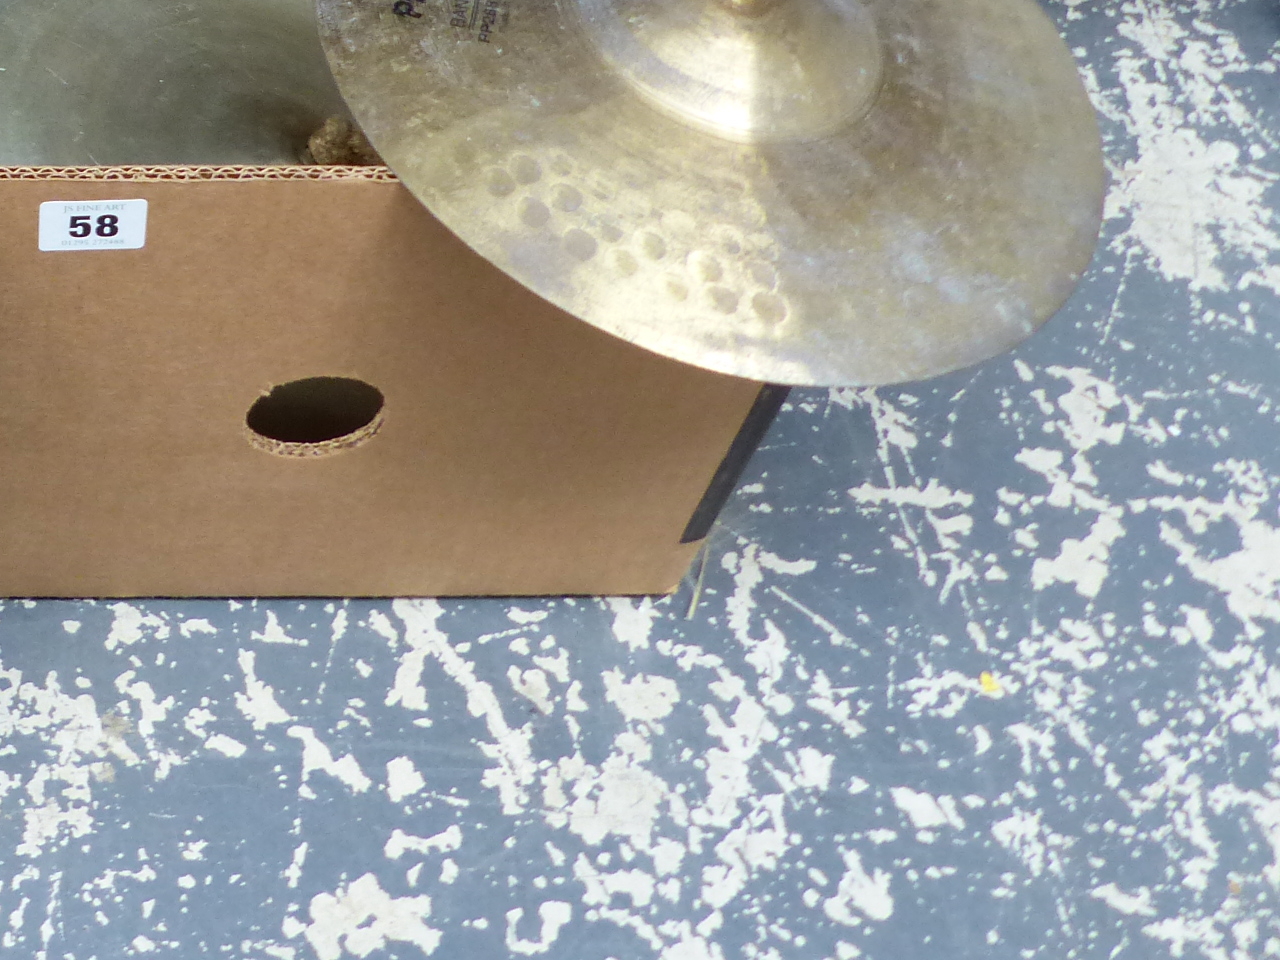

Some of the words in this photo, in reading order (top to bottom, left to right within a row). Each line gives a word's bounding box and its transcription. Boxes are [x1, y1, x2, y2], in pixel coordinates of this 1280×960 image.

[63, 204, 74, 214] JS
[76, 203, 102, 213] FINE
[104, 202, 127, 212] ART
[68, 214, 120, 239] 58
